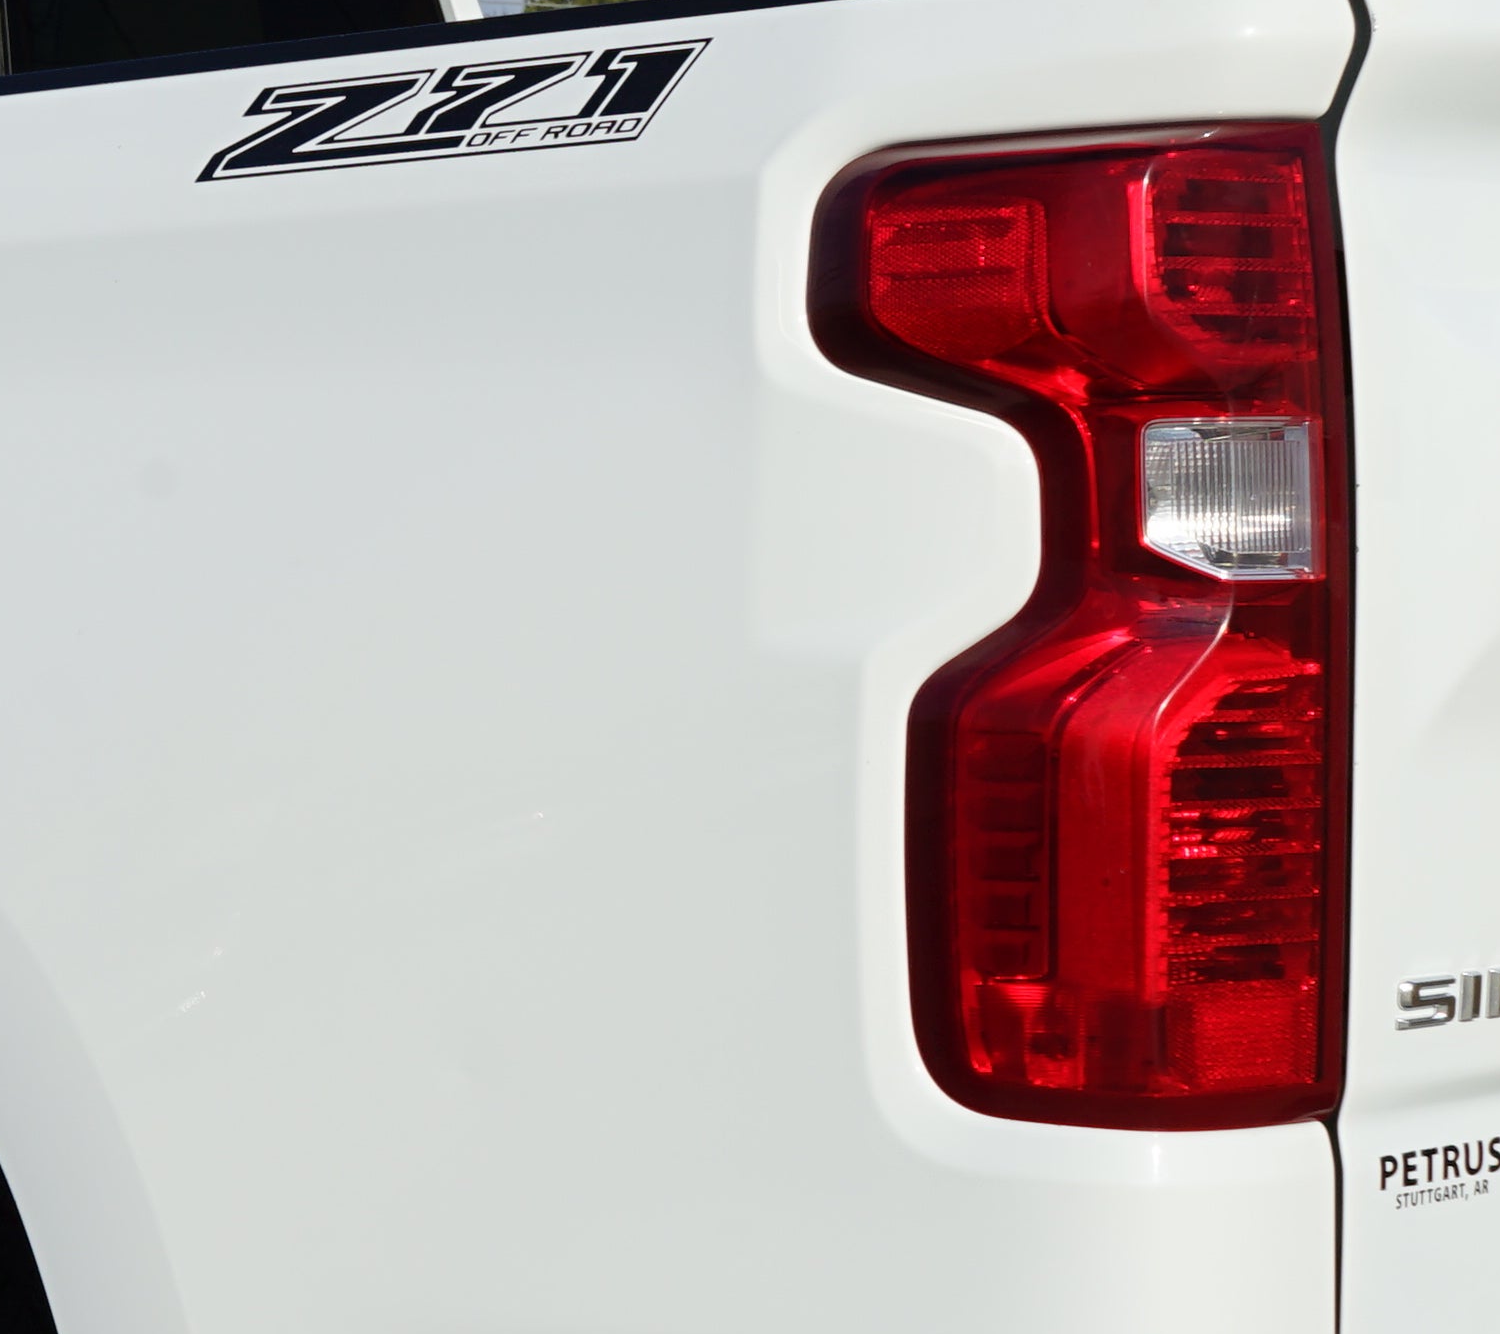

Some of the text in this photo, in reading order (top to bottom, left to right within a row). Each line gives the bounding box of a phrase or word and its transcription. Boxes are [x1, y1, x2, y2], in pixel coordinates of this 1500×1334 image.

[195, 38, 713, 183] Z71
[465, 117, 642, 148] OFF ROAD
[1395, 1179, 1490, 1210] STUTTGART, AR
